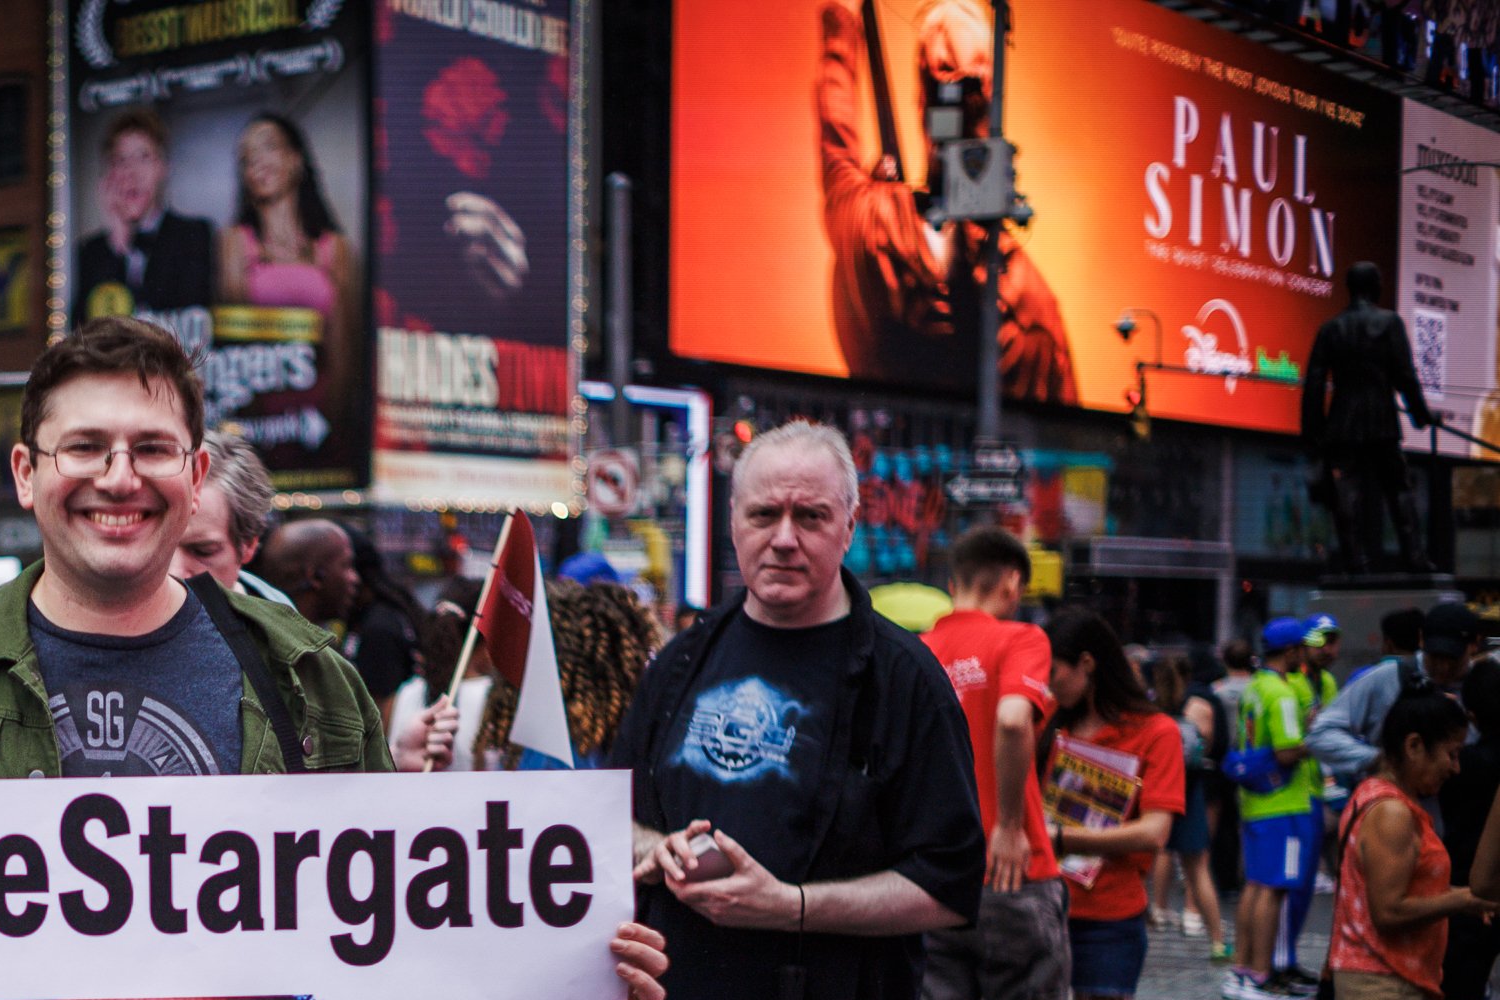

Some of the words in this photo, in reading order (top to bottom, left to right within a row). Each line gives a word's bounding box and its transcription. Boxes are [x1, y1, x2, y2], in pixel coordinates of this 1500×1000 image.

[1172, 95, 1315, 204] PAUL
[1144, 162, 1335, 277] SIMON
[86, 690, 125, 748] SG
